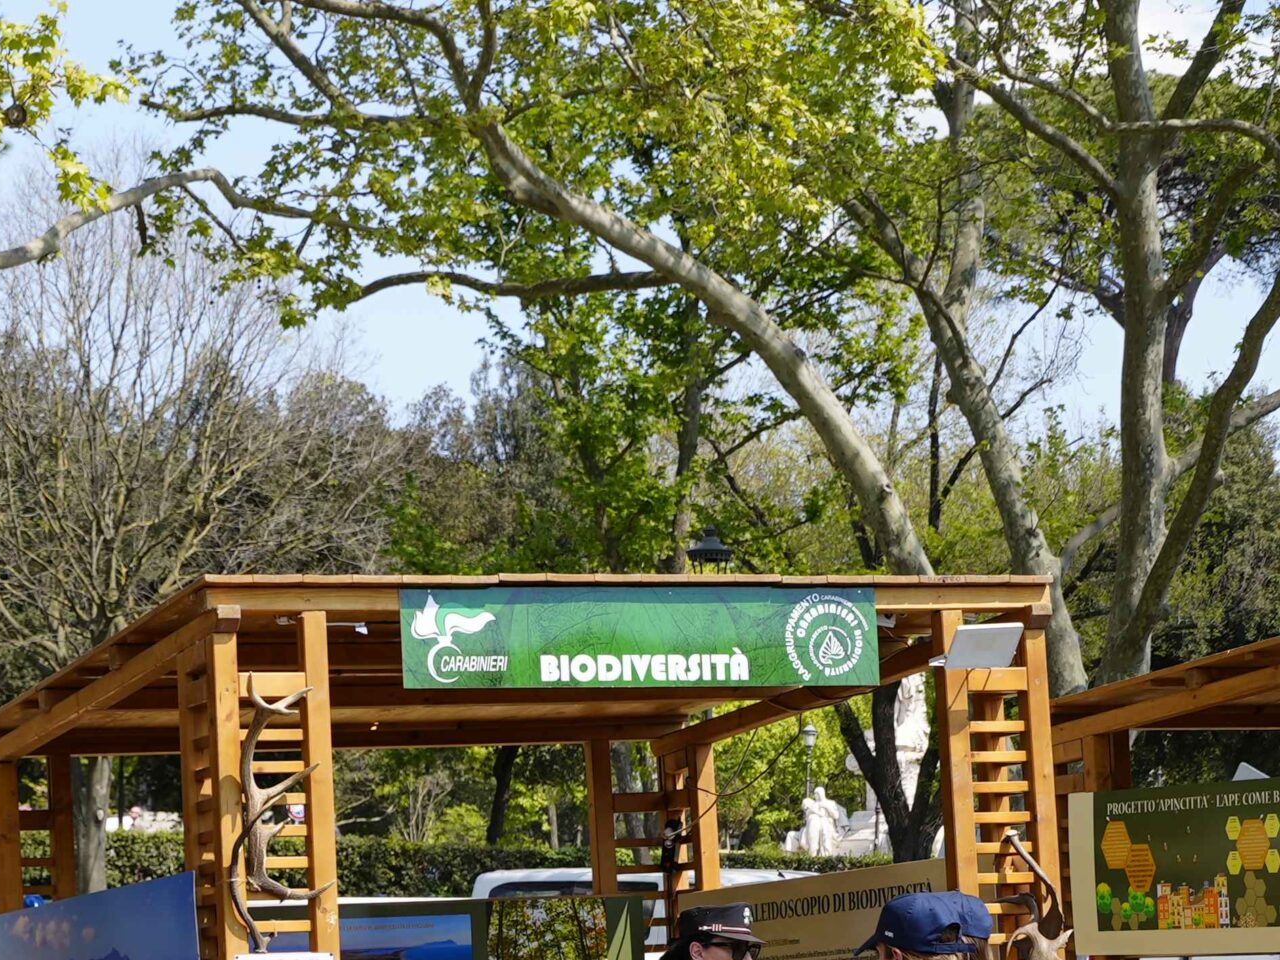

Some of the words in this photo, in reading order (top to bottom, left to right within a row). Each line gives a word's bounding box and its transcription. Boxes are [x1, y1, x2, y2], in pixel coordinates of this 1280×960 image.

[785, 593, 820, 681] RAGGRUPPAMENTO
[440, 655, 508, 673] CARABINIERI
[540, 647, 750, 682] BIODIVERSITÀ
[1106, 801, 1156, 815] PROGETTO
[1242, 790, 1271, 805] COME
[750, 894, 829, 923] LEIDOSCOPIO
[833, 892, 846, 912] DI
